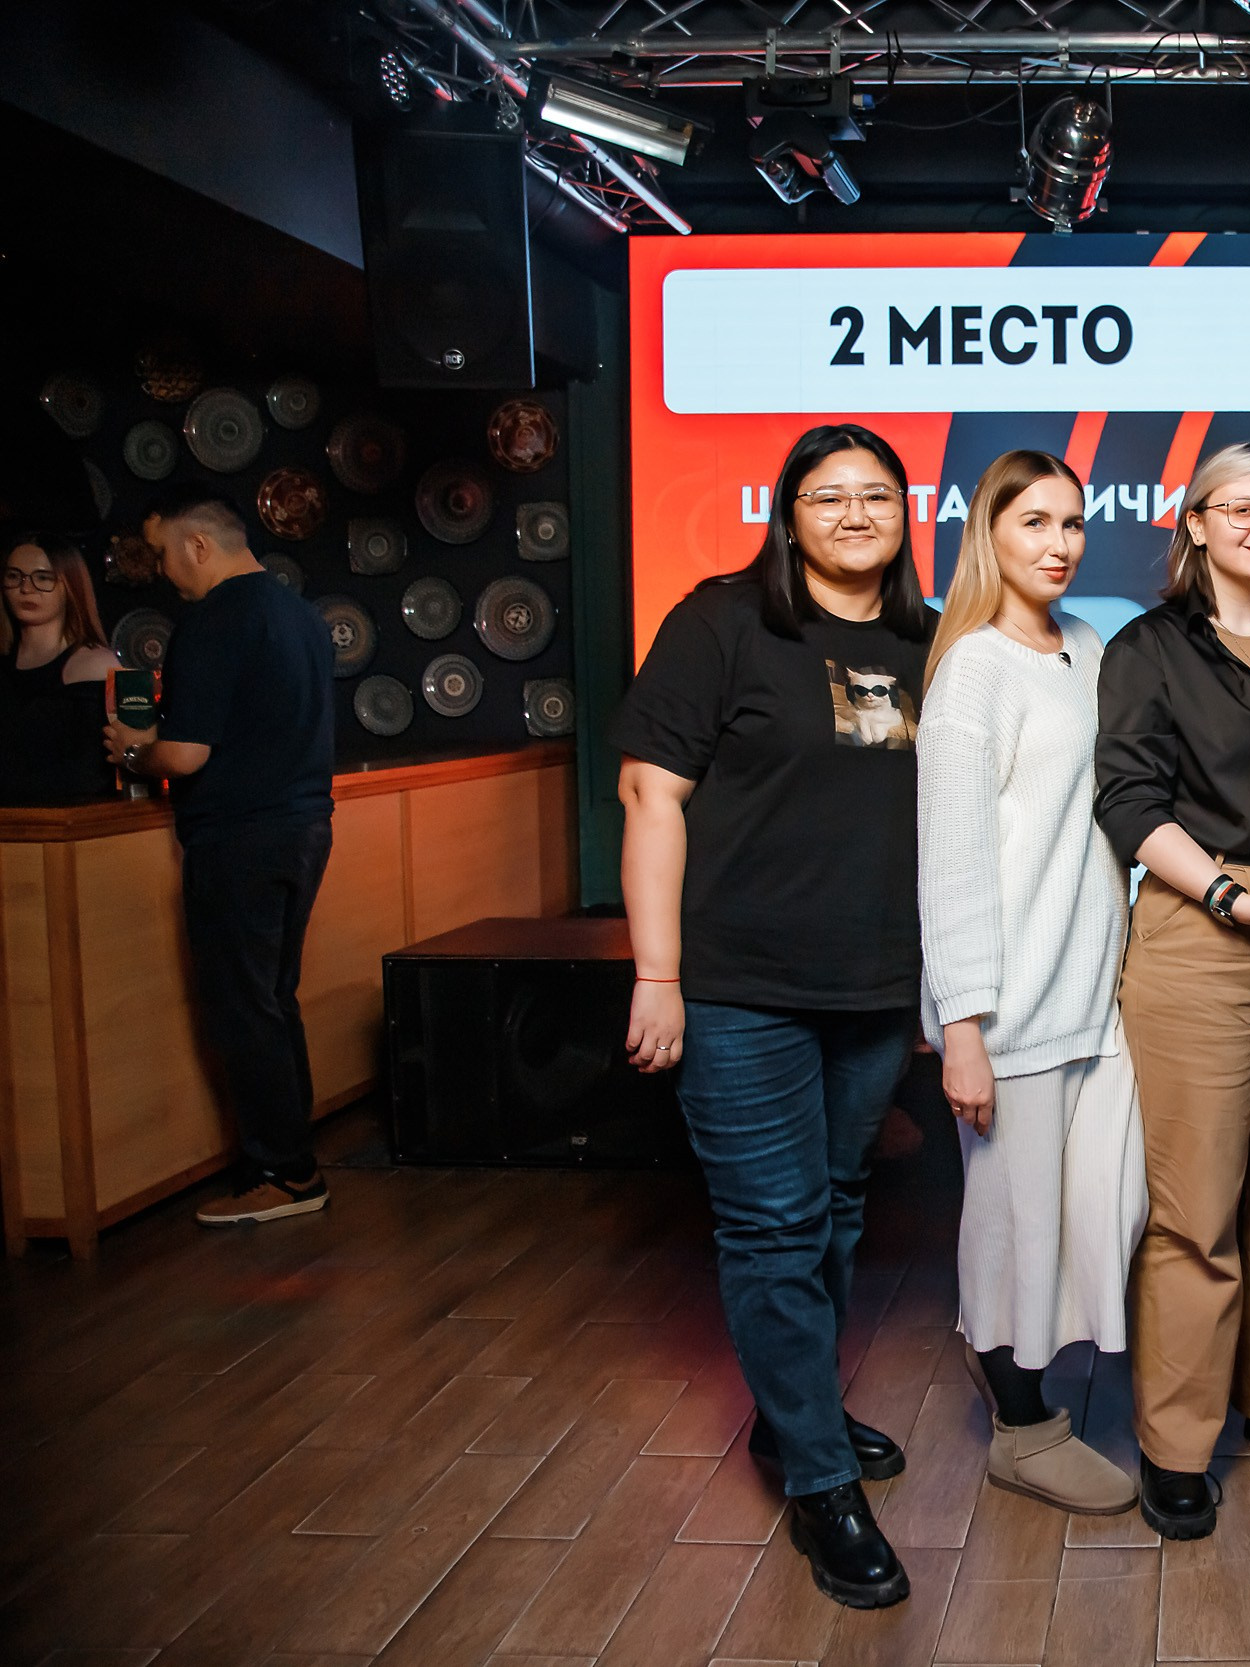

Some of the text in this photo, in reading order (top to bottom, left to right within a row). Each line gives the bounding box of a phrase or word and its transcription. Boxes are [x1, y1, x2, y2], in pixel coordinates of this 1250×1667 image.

[829, 304, 1133, 366] 2 МЕСТО
[445, 354, 462, 364] RCF
